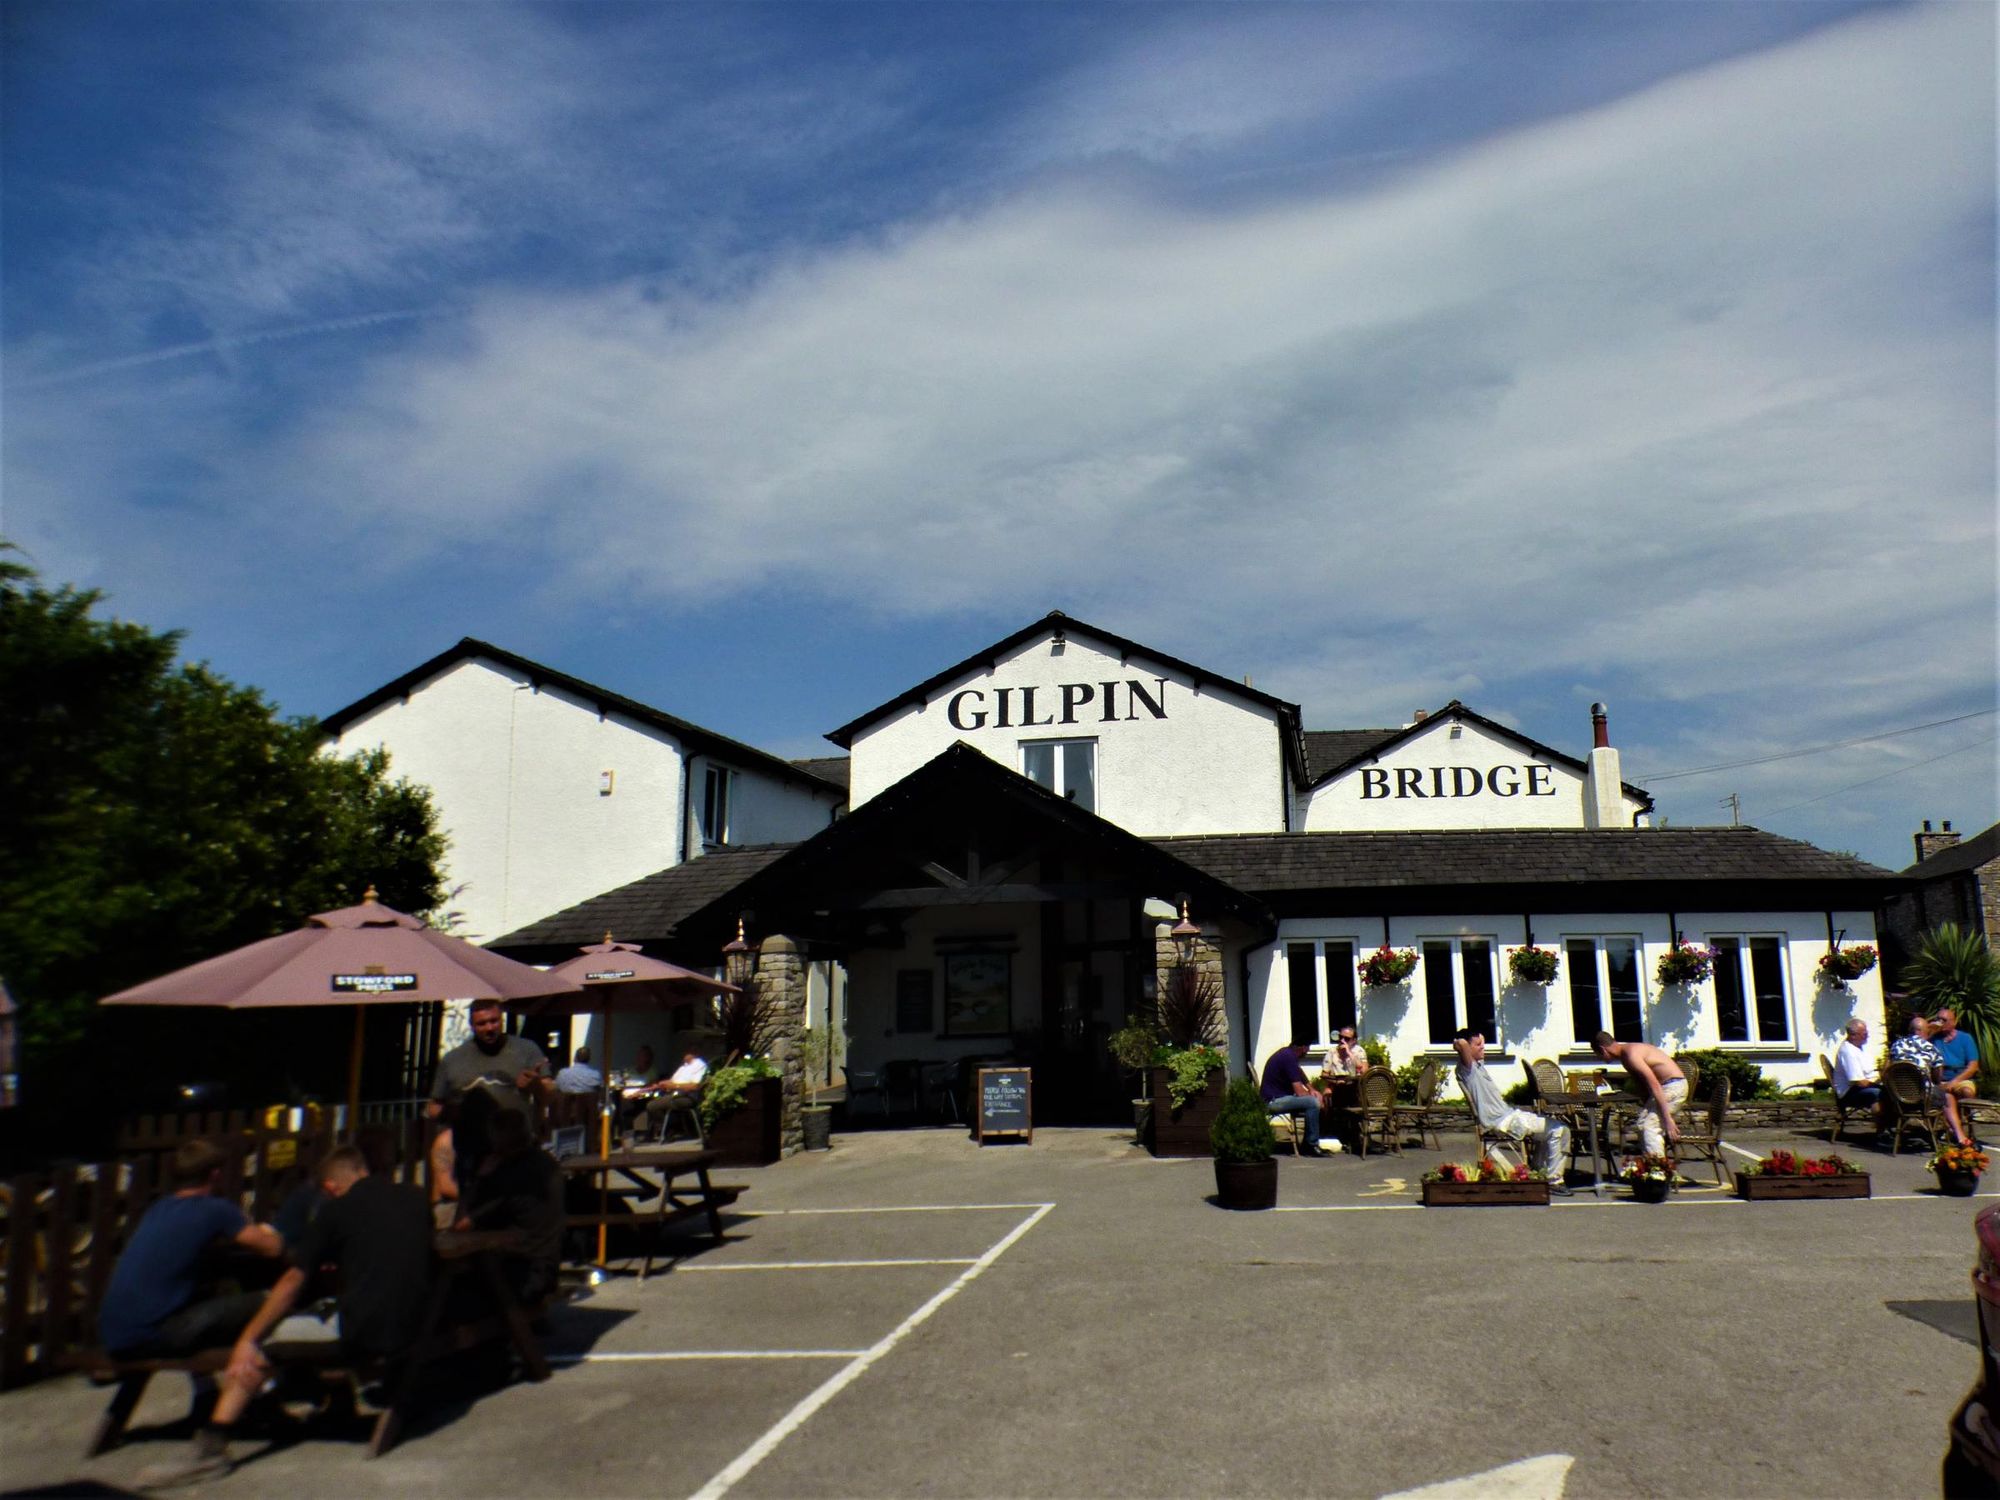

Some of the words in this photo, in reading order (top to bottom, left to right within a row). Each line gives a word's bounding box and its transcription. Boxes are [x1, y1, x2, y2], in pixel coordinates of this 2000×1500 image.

[947, 678, 1169, 731] GILPIN
[1358, 764, 1557, 799] BRIDGE
[335, 976, 414, 985] STOWFORD
